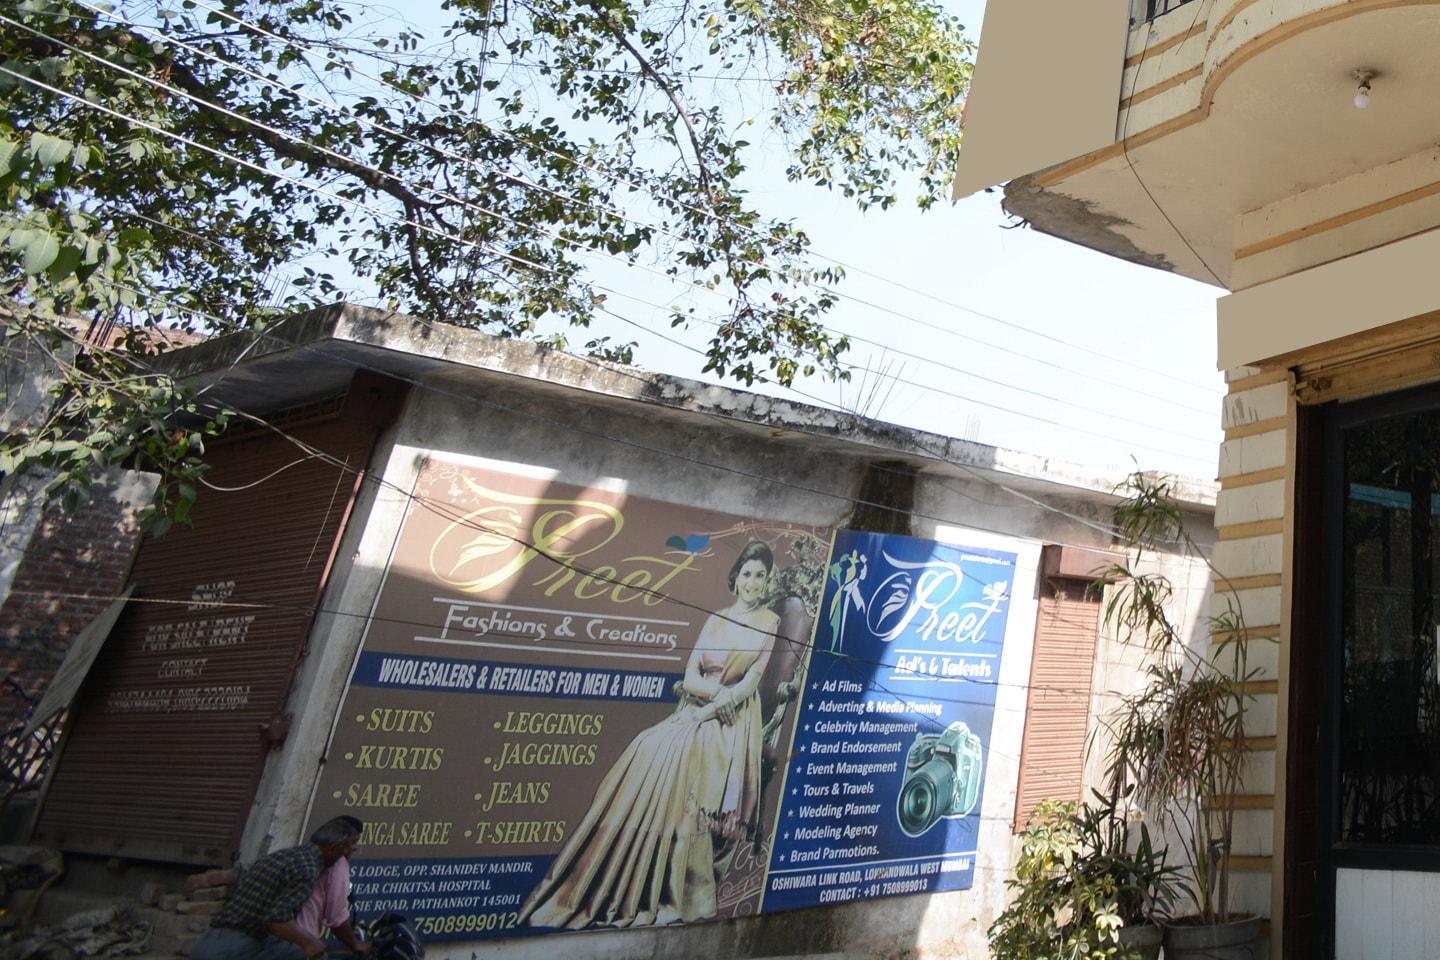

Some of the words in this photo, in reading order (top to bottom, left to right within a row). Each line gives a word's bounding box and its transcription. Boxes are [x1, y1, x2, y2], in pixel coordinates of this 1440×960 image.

[430, 474, 702, 607] Preet
[867, 550, 1003, 644] Preet
[440, 604, 547, 642] Fashions
[554, 616, 576, 638] &
[586, 619, 678, 652] Creations
[942, 657, 992, 677] Talents
[378, 657, 476, 689] WHOLESALERS
[477, 667, 489, 687] &
[489, 666, 555, 694] RETAILERS
[557, 671, 582, 693] FOR
[584, 673, 610, 696] MEN
[610, 676, 621, 697] &
[623, 675, 666, 699] WOMEN
[822, 680, 836, 692] Ad
[838, 680, 863, 693] Films
[818, 701, 865, 716] Adverting
[866, 701, 874, 713] &
[876, 701, 904, 713] Media
[905, 702, 943, 716] Planning
[366, 707, 435, 734] SUITS
[502, 711, 604, 736] LEGGINGS
[814, 721, 857, 735] Celebrity
[859, 721, 918, 735] Management
[355, 745, 444, 771] KURTIS
[492, 743, 598, 772] JAGGINGS
[810, 742, 840, 754] Brand
[841, 742, 902, 753] Endorsement
[806, 763, 834, 775] Event
[836, 762, 898, 776] Management
[344, 783, 422, 808] SAREE
[482, 782, 551, 812] JEANS
[803, 784, 830, 797] Tours
[831, 783, 840, 795] &
[842, 781, 875, 795] Travels
[799, 803, 842, 819] Wedding
[844, 802, 881, 816] Planner
[357, 822, 395, 846] INGA
[398, 822, 453, 846] SAREE
[475, 820, 566, 845] T-SHIRTS
[794, 826, 842, 841] Modeling
[843, 824, 878, 839] Agency
[790, 848, 821, 863] Brand
[822, 845, 880, 861] Parmotions.
[358, 864, 401, 878] LODGE,
[404, 864, 428, 877] OPP.
[430, 863, 487, 876] SHANIDEV
[489, 862, 533, 874] MANDIR,
[772, 874, 817, 891] OSHIWARA
[819, 872, 837, 886] LINK
[839, 869, 863, 885] ROAD,
[920, 861, 940, 874] WEST
[352, 882, 380, 895] EAR
[382, 881, 436, 894] CHIKITSA
[438, 879, 491, 892] HOSPITAL
[819, 887, 856, 903] CONTACT
[863, 883, 880, 897] +91
[412, 896, 480, 909] PATHANKOT
[481, 894, 521, 907] 145001
[415, 912, 518, 935] 7508999012
